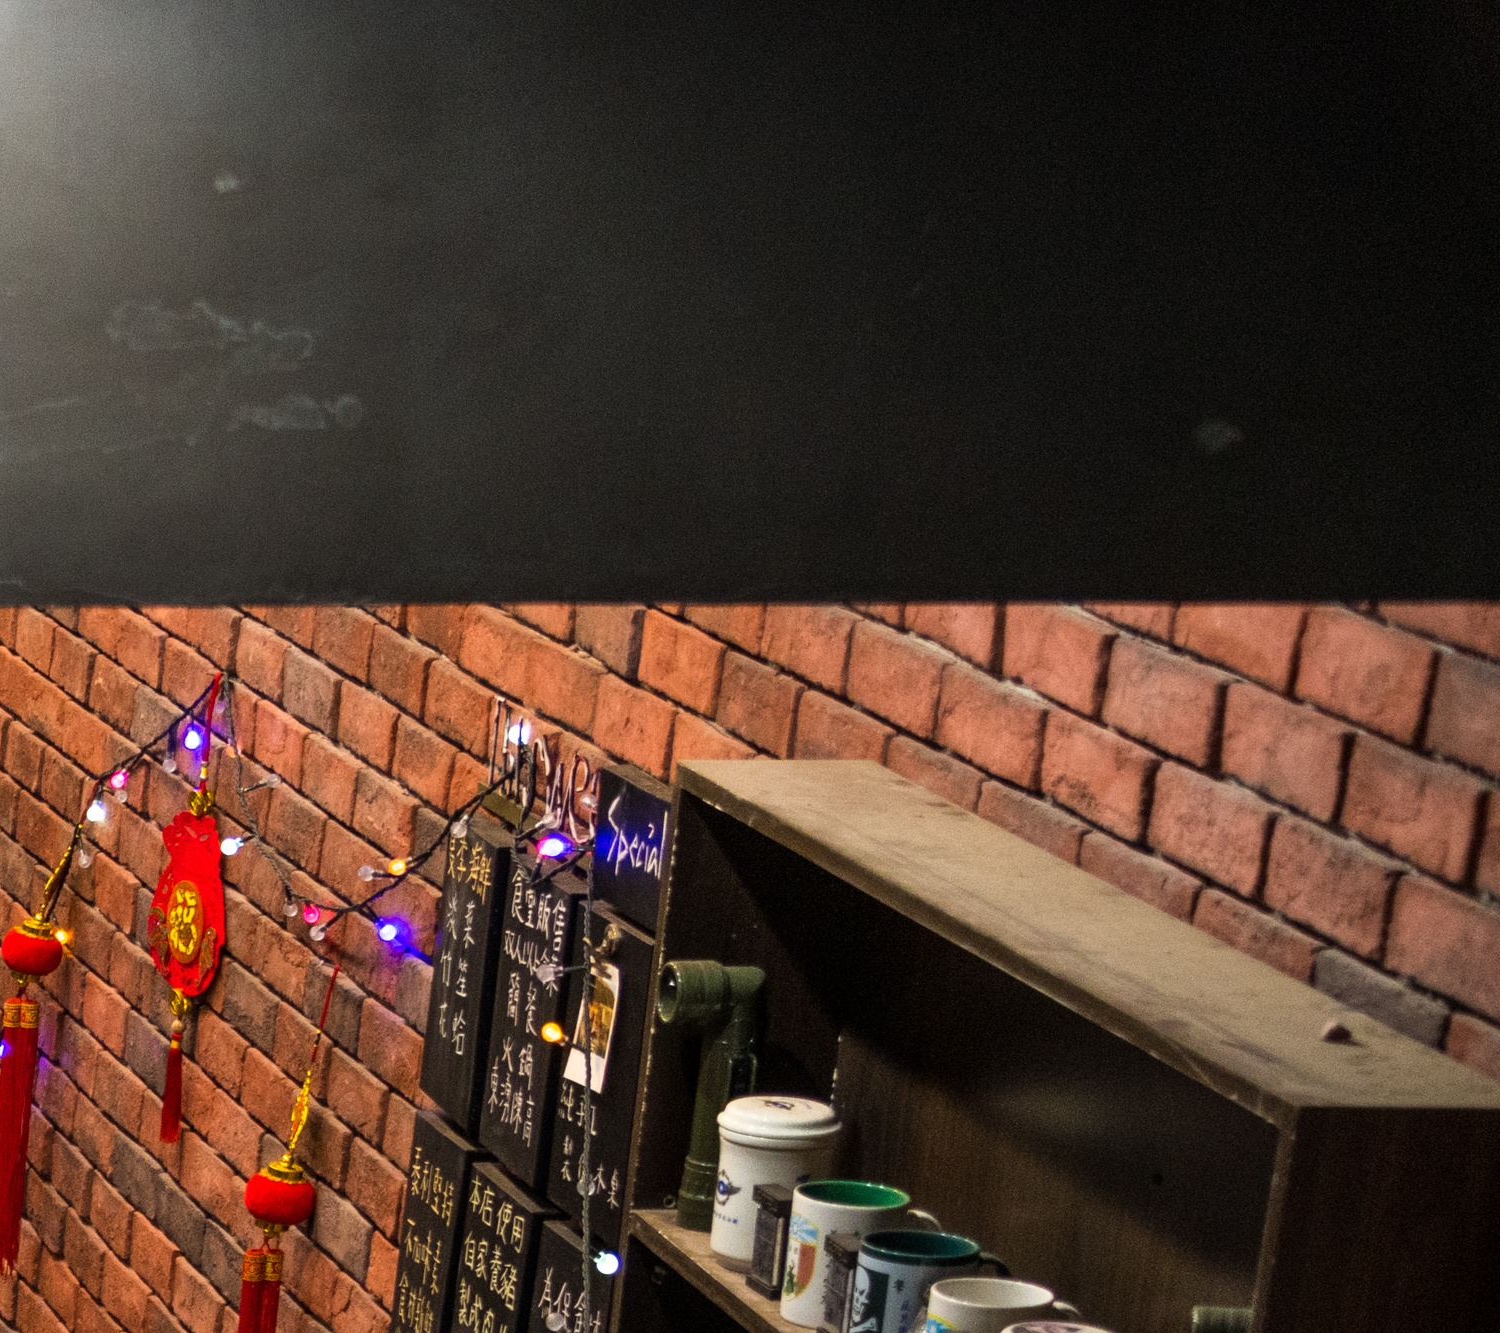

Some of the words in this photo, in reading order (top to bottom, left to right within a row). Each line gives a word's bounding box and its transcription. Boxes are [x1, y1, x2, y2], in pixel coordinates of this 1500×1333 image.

[607, 795, 668, 880] Special
[502, 1037, 532, 1091] 火鍋
[469, 1175, 525, 1254] 本店使用
[464, 1230, 518, 1311] 自家養豬
